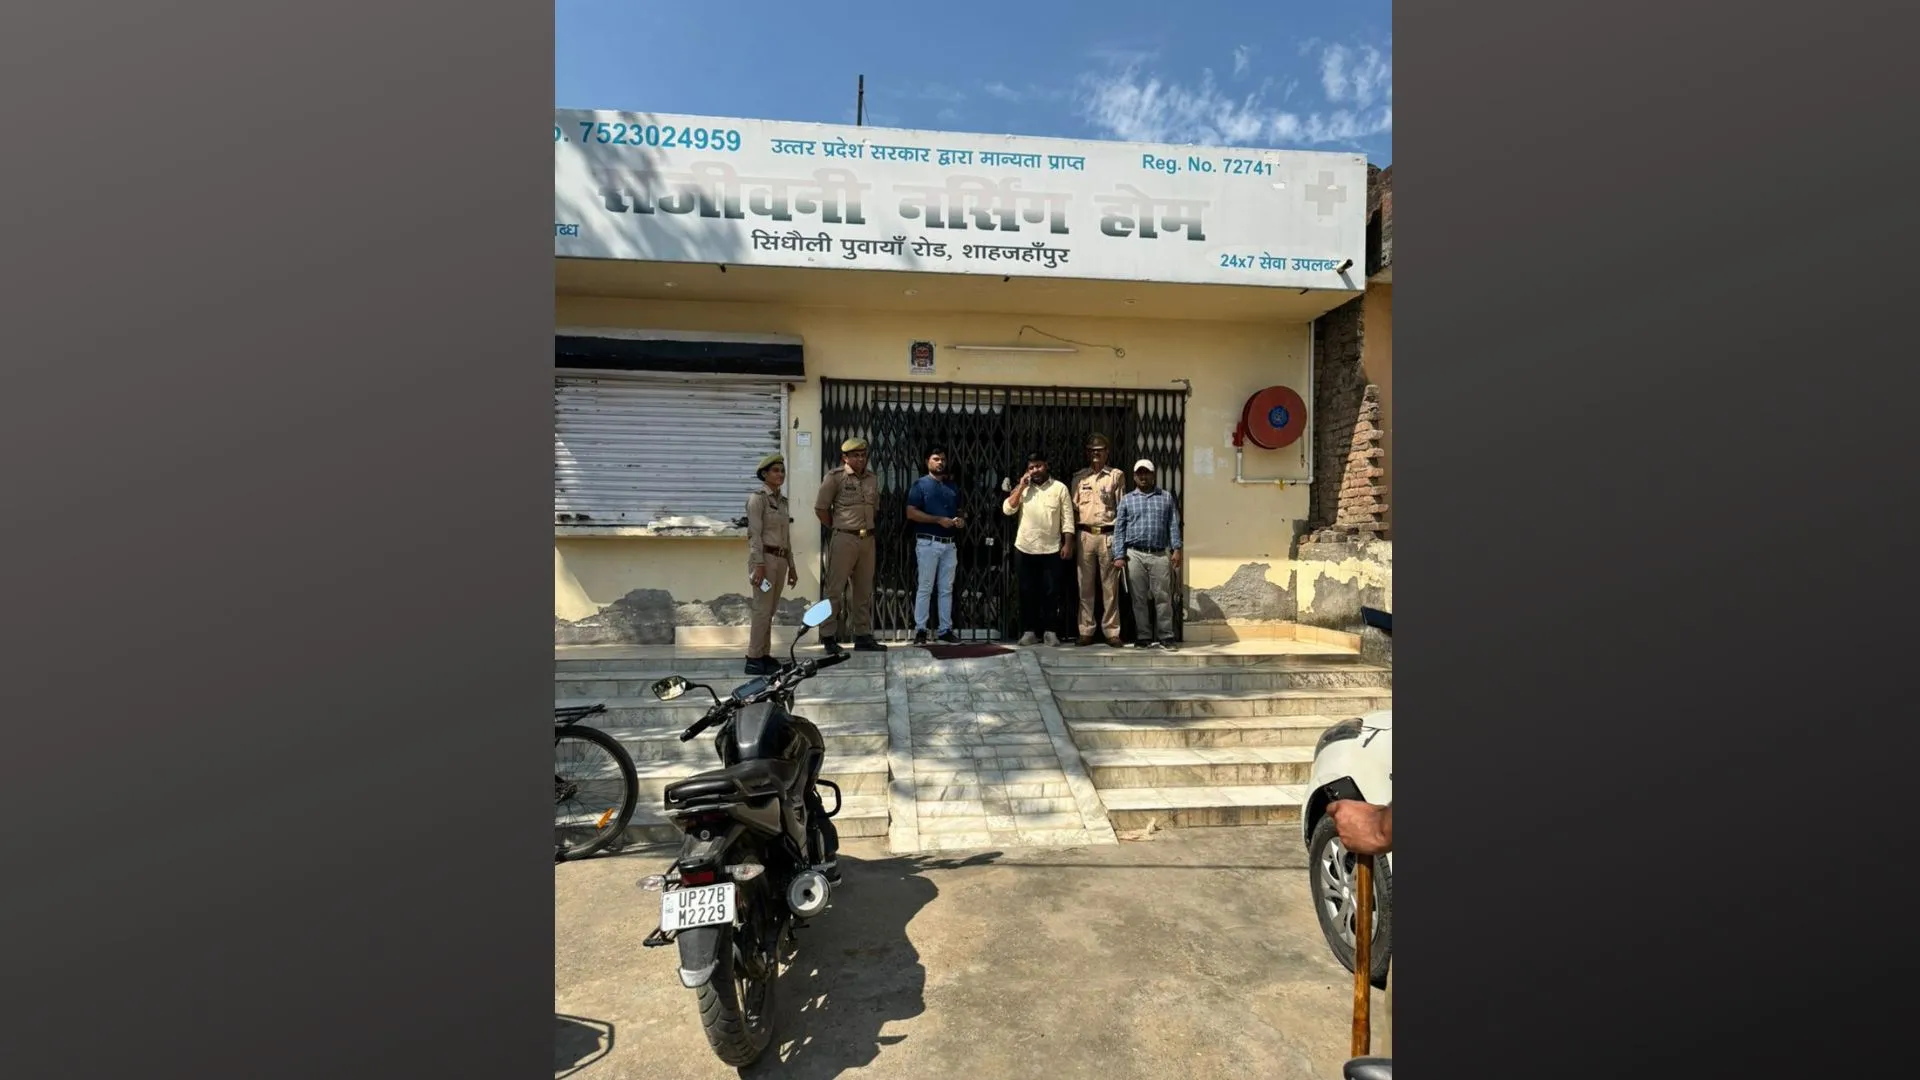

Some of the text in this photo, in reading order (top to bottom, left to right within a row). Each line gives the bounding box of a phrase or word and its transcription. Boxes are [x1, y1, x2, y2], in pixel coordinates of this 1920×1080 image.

[580, 121, 741, 151] 7523024959
[771, 136, 1086, 172] उत्तर प्रदेश सरकार द्वारा मान्यता प्राप्त
[1143, 153, 1181, 175] Reg.
[1188, 156, 1217, 173] No.
[1095, 183, 1211, 242] होम
[751, 229, 1071, 269] सिंधौली पुवायाँ रोड, शाहजहाँपुर
[1220, 254, 1255, 269] 24x7
[1258, 251, 1287, 271] सेवा
[679, 886, 725, 909] UP27B
[679, 904, 726, 927] M2229
